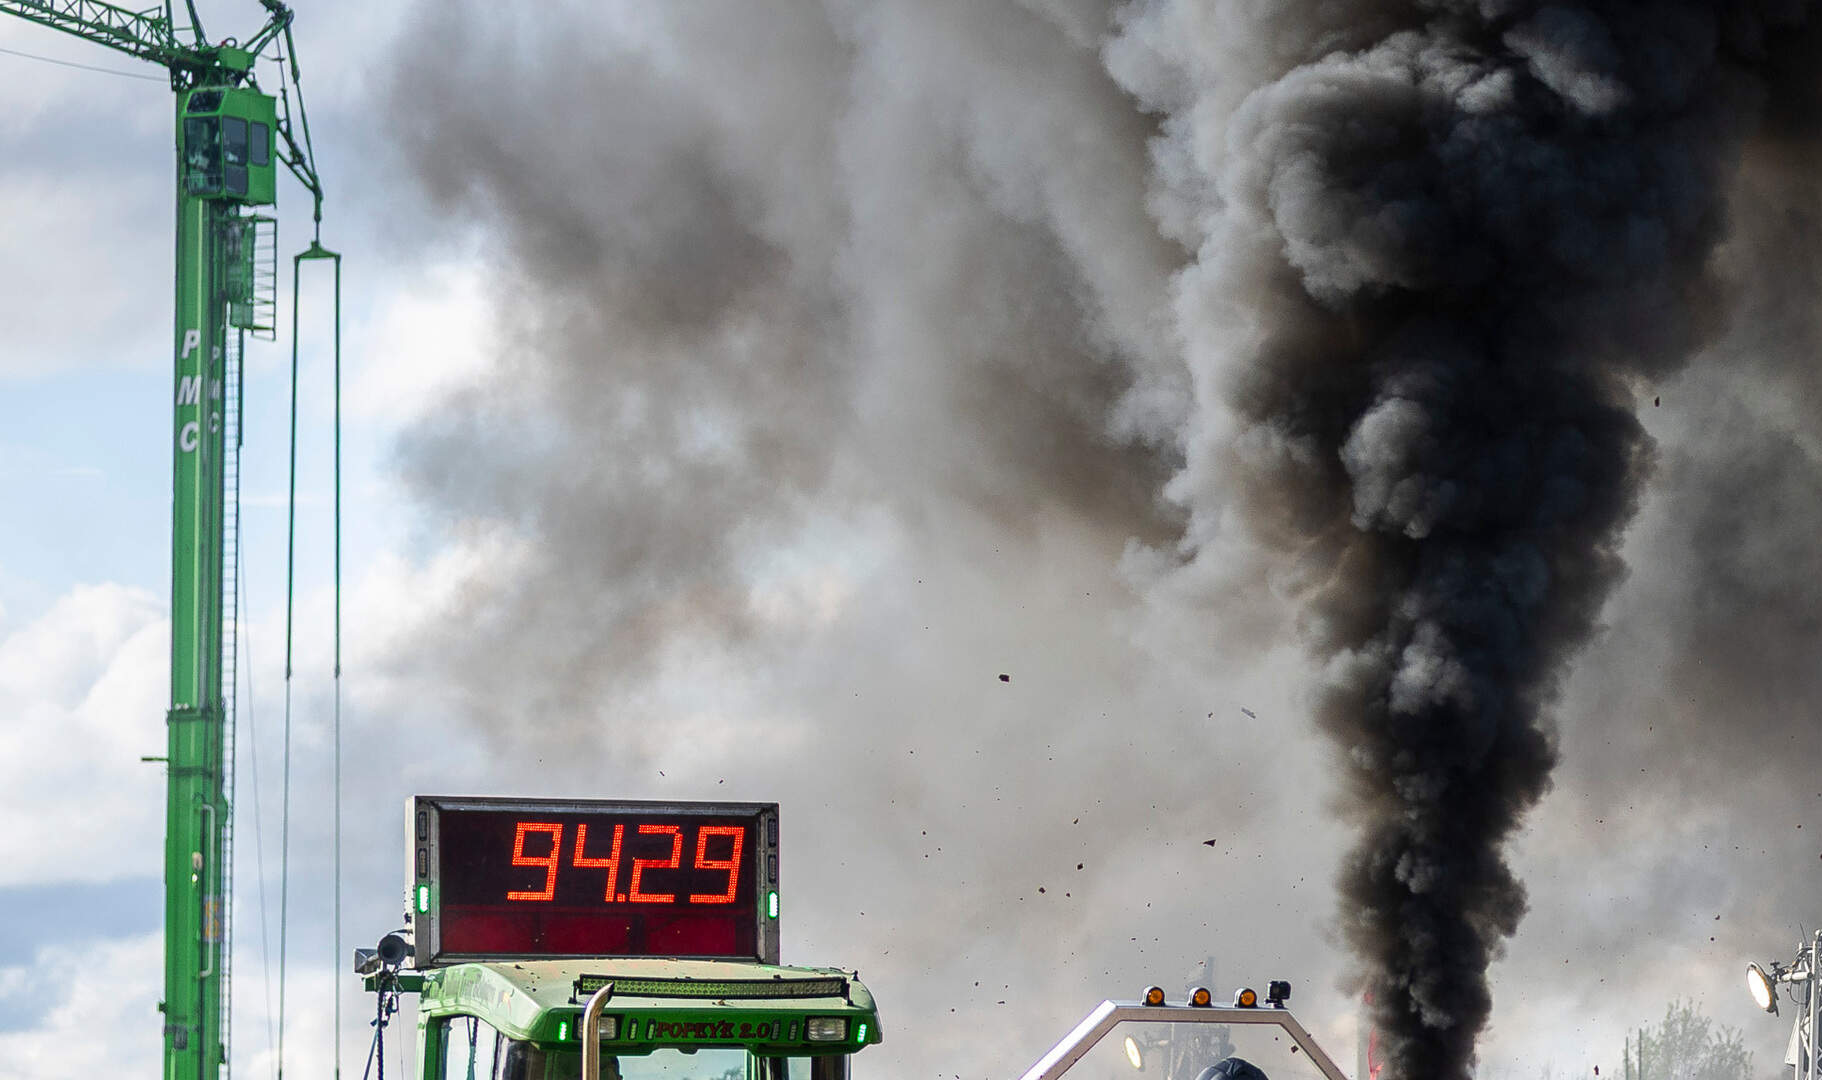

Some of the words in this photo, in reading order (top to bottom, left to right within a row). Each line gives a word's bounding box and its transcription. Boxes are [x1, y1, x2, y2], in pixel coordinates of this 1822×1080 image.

[177, 329, 202, 453] PMC
[507, 821, 745, 904] 94.29
[656, 1019, 735, 1039] POPEYE
[738, 1022, 770, 1039] 2.0
